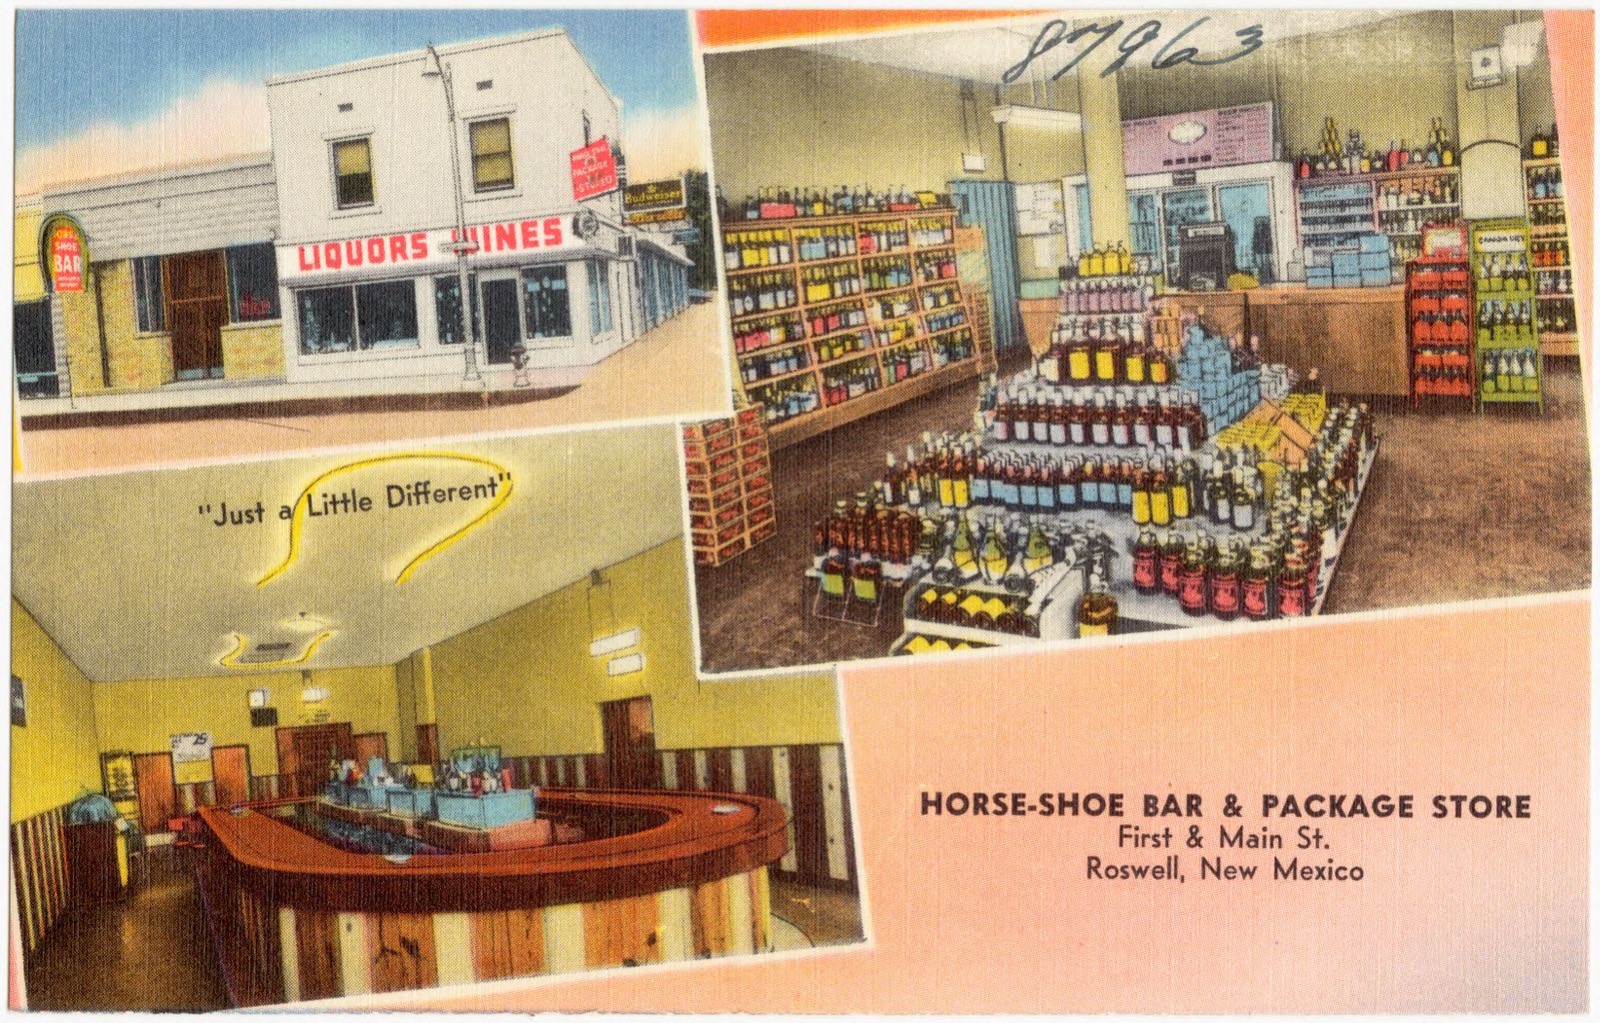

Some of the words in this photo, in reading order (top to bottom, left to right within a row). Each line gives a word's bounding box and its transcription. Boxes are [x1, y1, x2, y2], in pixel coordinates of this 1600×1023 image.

[54, 241, 78, 251] SHOE
[298, 232, 428, 271] LIQUORS
[452, 217, 563, 255] WINES
[53, 254, 82, 273] BAR
